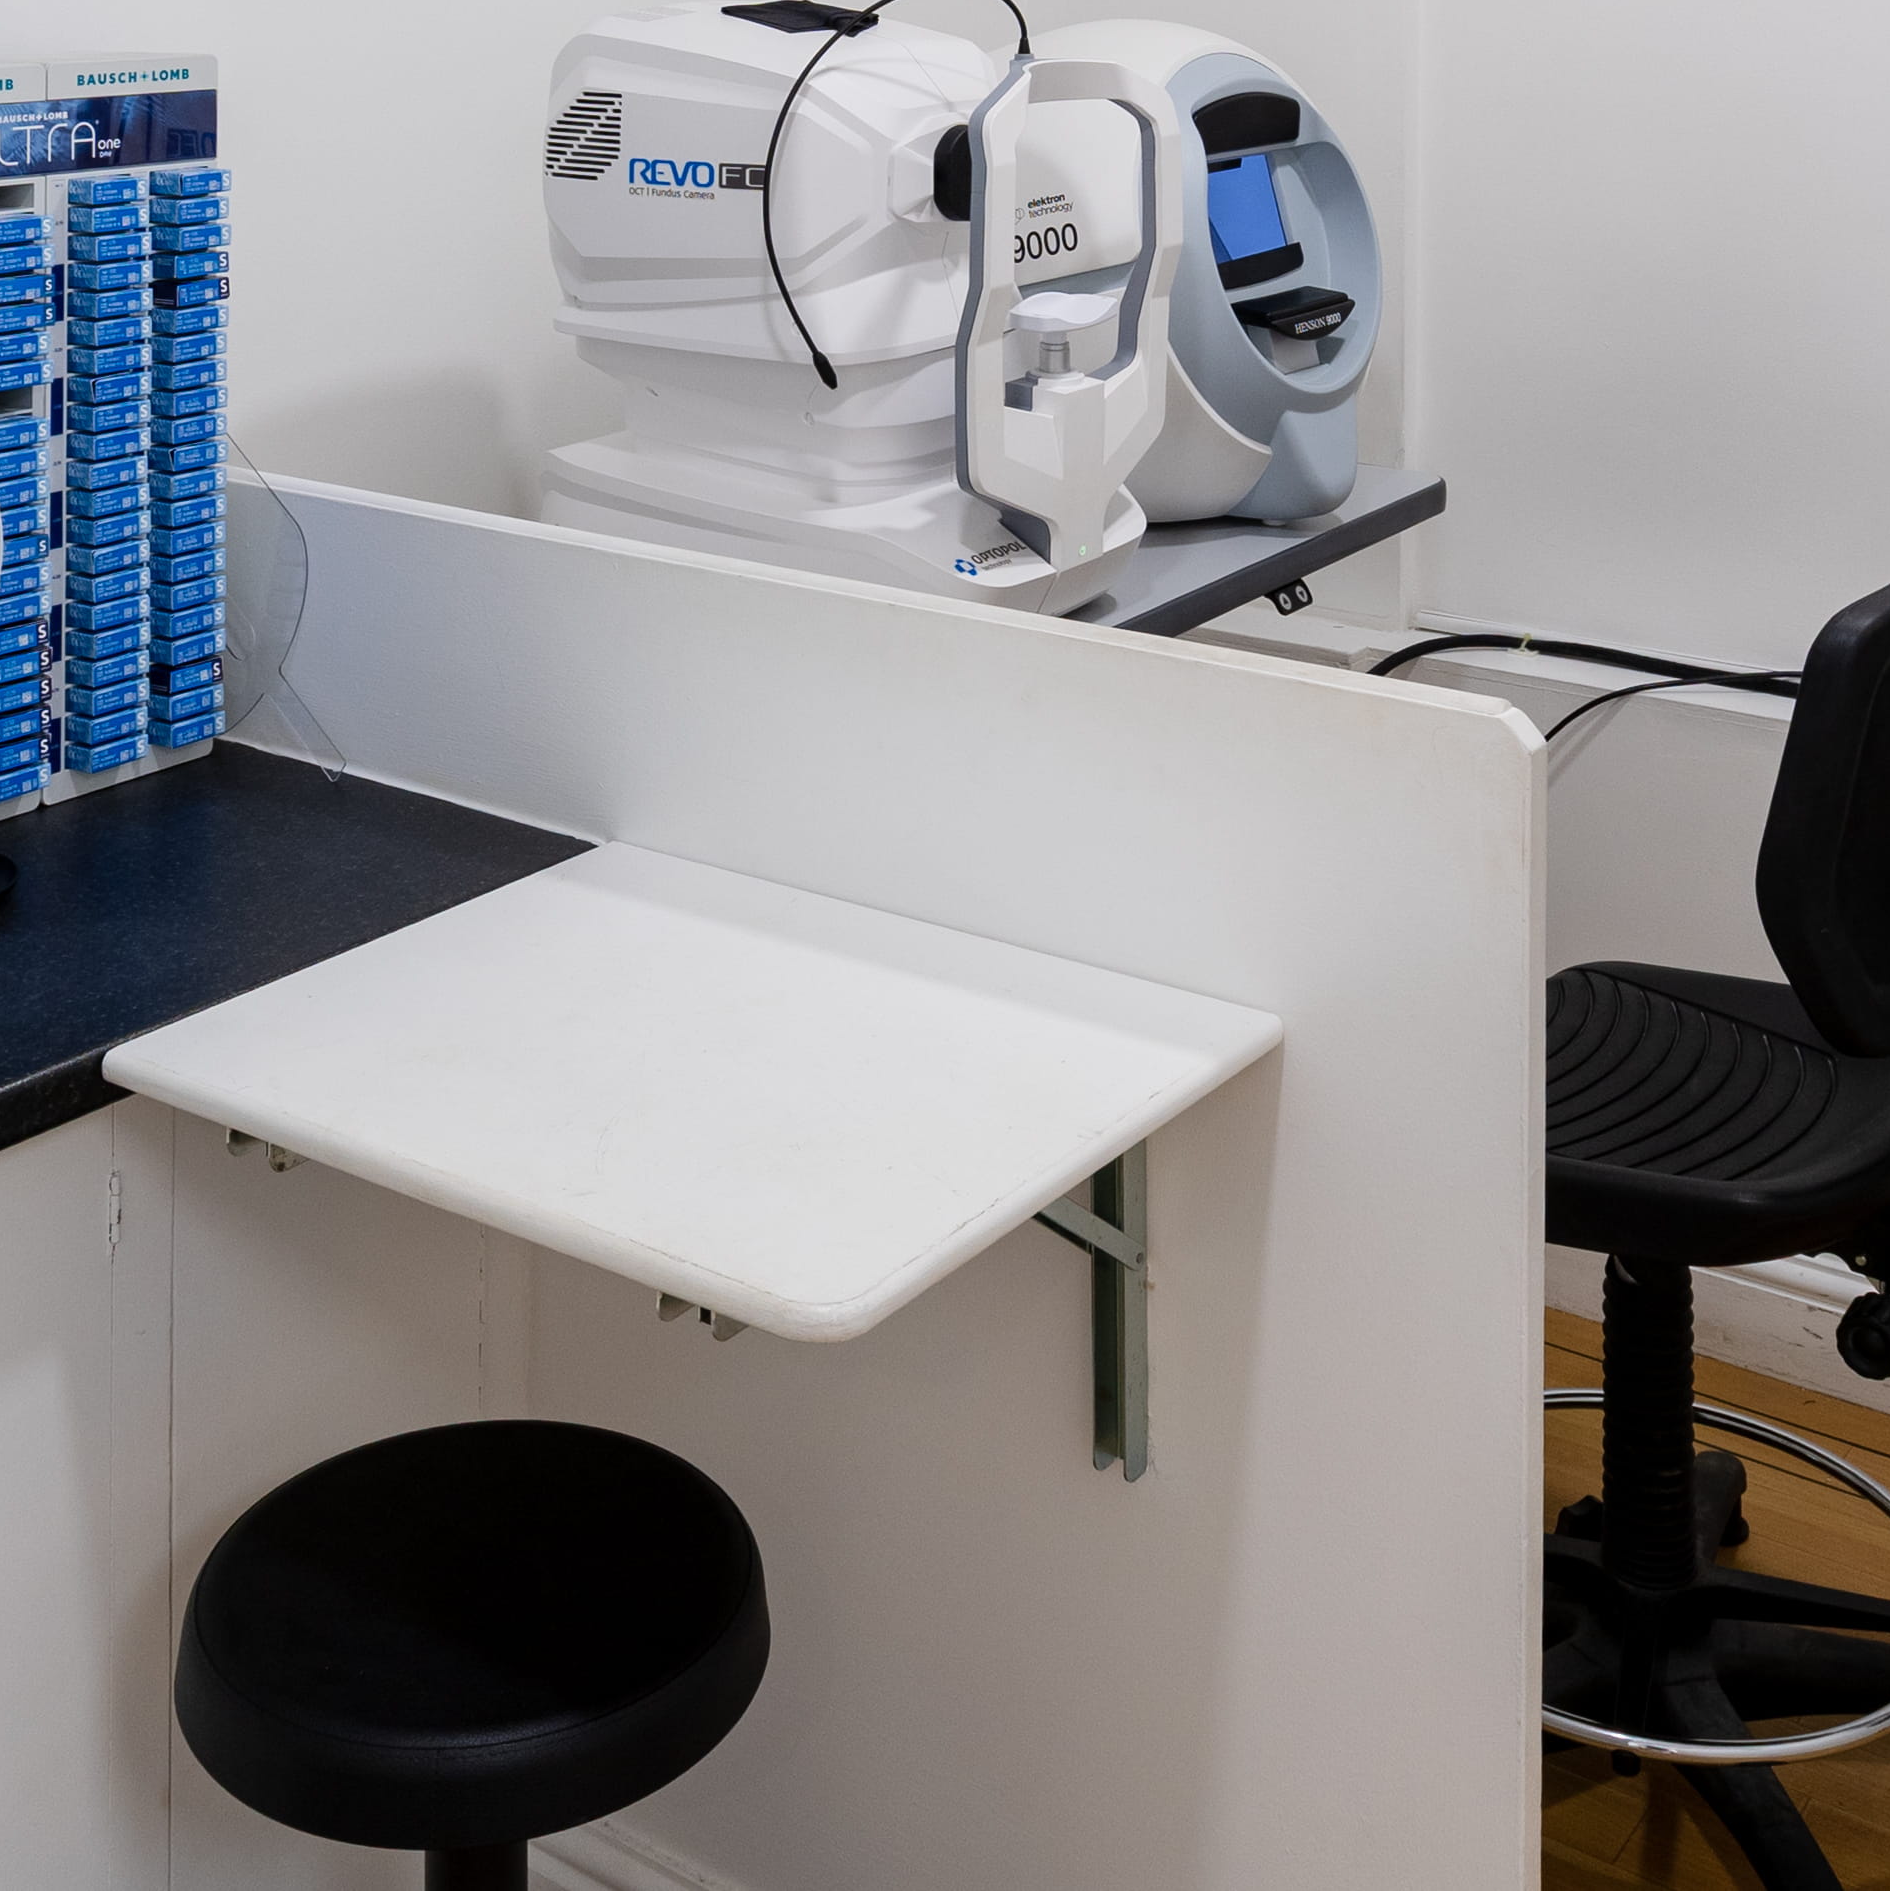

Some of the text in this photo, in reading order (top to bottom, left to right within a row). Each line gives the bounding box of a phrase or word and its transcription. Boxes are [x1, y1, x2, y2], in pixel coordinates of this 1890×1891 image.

[97, 137, 121, 150] one
[629, 158, 714, 188] REVO
[629, 187, 715, 200] OCT Fundus Camera
[1028, 194, 1065, 208] elektron
[1029, 201, 1074, 218] technology
[1014, 223, 1078, 263] 9000
[1294, 312, 1341, 334] HENSON 9000
[971, 541, 1027, 565] OPTOPOL
